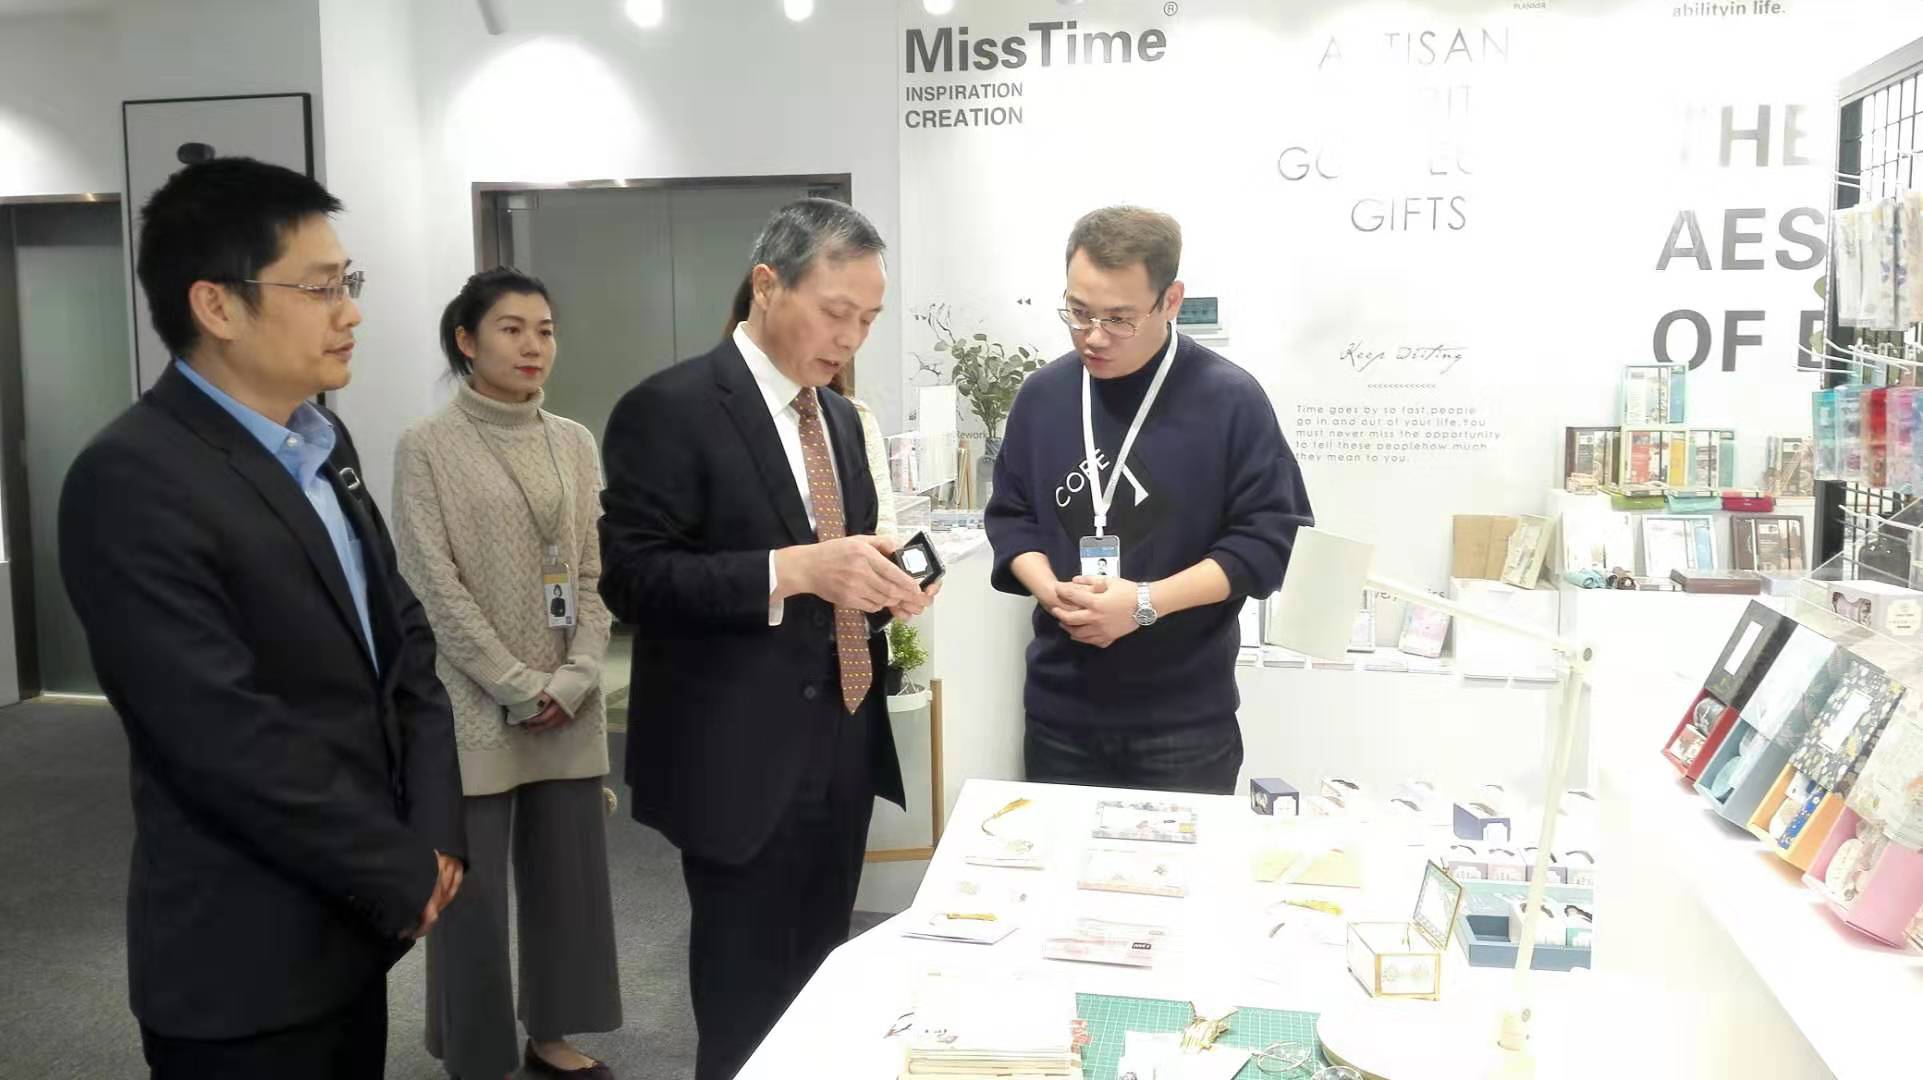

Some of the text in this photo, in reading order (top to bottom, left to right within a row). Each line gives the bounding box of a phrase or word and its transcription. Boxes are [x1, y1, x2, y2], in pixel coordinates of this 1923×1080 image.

[1318, 27, 1510, 70] ATISAN
[906, 82, 1023, 102] INSPIRATION
[905, 106, 1023, 129] CREATION
[1350, 196, 1467, 233] GIFTS
[1652, 309, 1766, 373] OF
[1297, 404, 1324, 414] Time
[1329, 407, 1358, 416] goes
[1363, 406, 1377, 415] by
[1296, 418, 1311, 427] go
[1316, 417, 1327, 425] in
[1332, 417, 1356, 426] and
[1361, 417, 1381, 426] out
[1387, 417, 1398, 426] of
[1404, 418, 1431, 427] your
[1296, 429, 1501, 440] must never miss the opportunity
[1296, 441, 1308, 449] to
[1313, 440, 1332, 449] tell
[1337, 440, 1371, 450] these
[1452, 441, 1487, 450] much
[1328, 454, 1361, 462] mean
[1366, 453, 1378, 462] to
